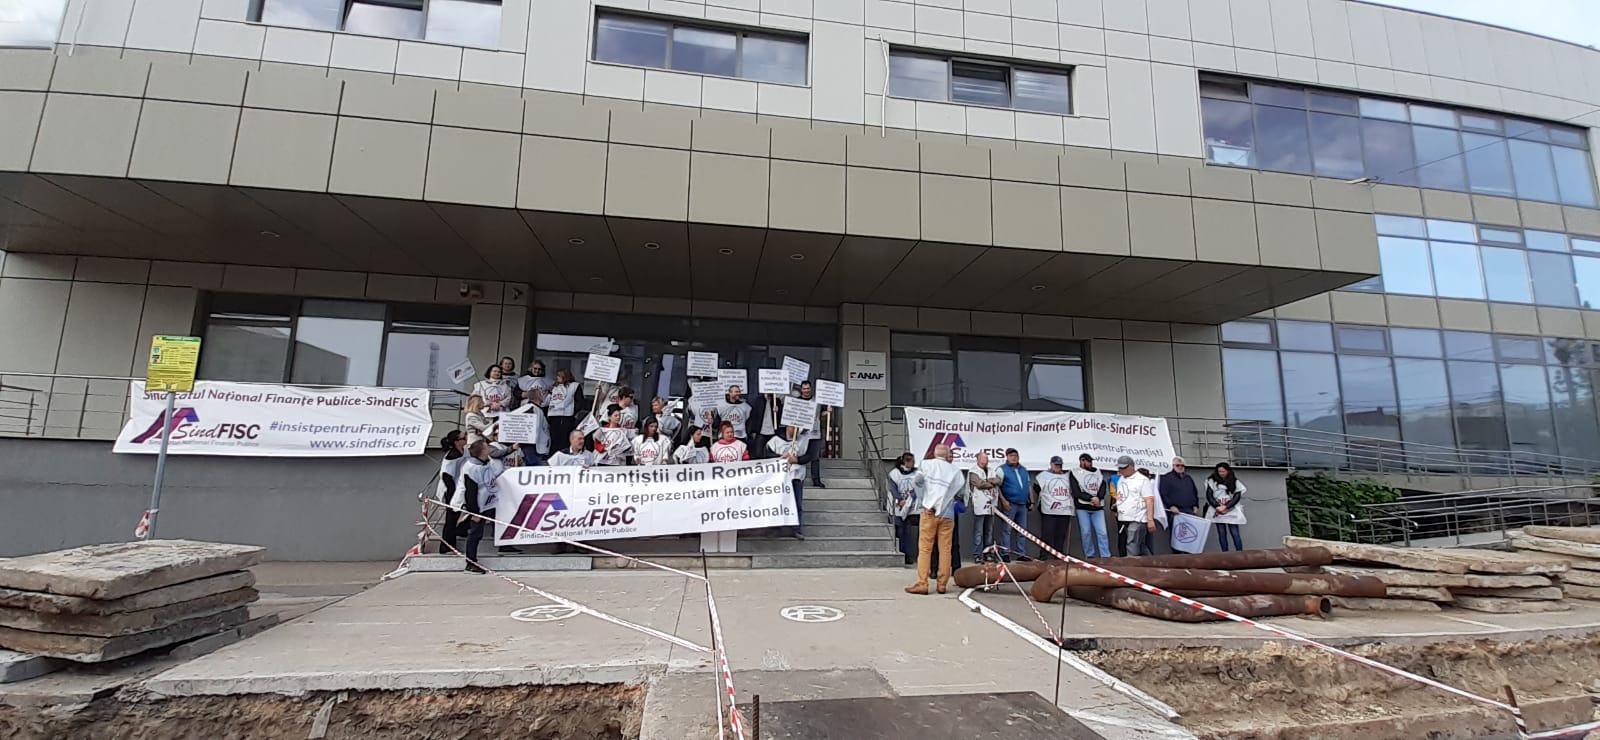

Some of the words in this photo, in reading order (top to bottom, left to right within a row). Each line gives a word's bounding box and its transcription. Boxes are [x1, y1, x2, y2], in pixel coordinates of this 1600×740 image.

[857, 372, 885, 380] ANAF
[143, 389, 206, 401] Sindcatul
[317, 396, 420, 408] Publice-SindFISC
[172, 423, 260, 440] SindFISC
[918, 418, 974, 432] Sindicatul
[1069, 419, 1157, 436] Publice-SindFISC
[309, 438, 416, 449] www.sindfisc.ro
[518, 470, 571, 486] Unim
[578, 467, 670, 487] finanțiștii
[676, 468, 705, 482] din
[712, 460, 790, 480] România
[588, 493, 602, 505] si
[607, 492, 620, 504] le
[724, 482, 791, 497] interesele
[540, 506, 637, 532] SindFISC
[701, 503, 794, 525] profesionale.
